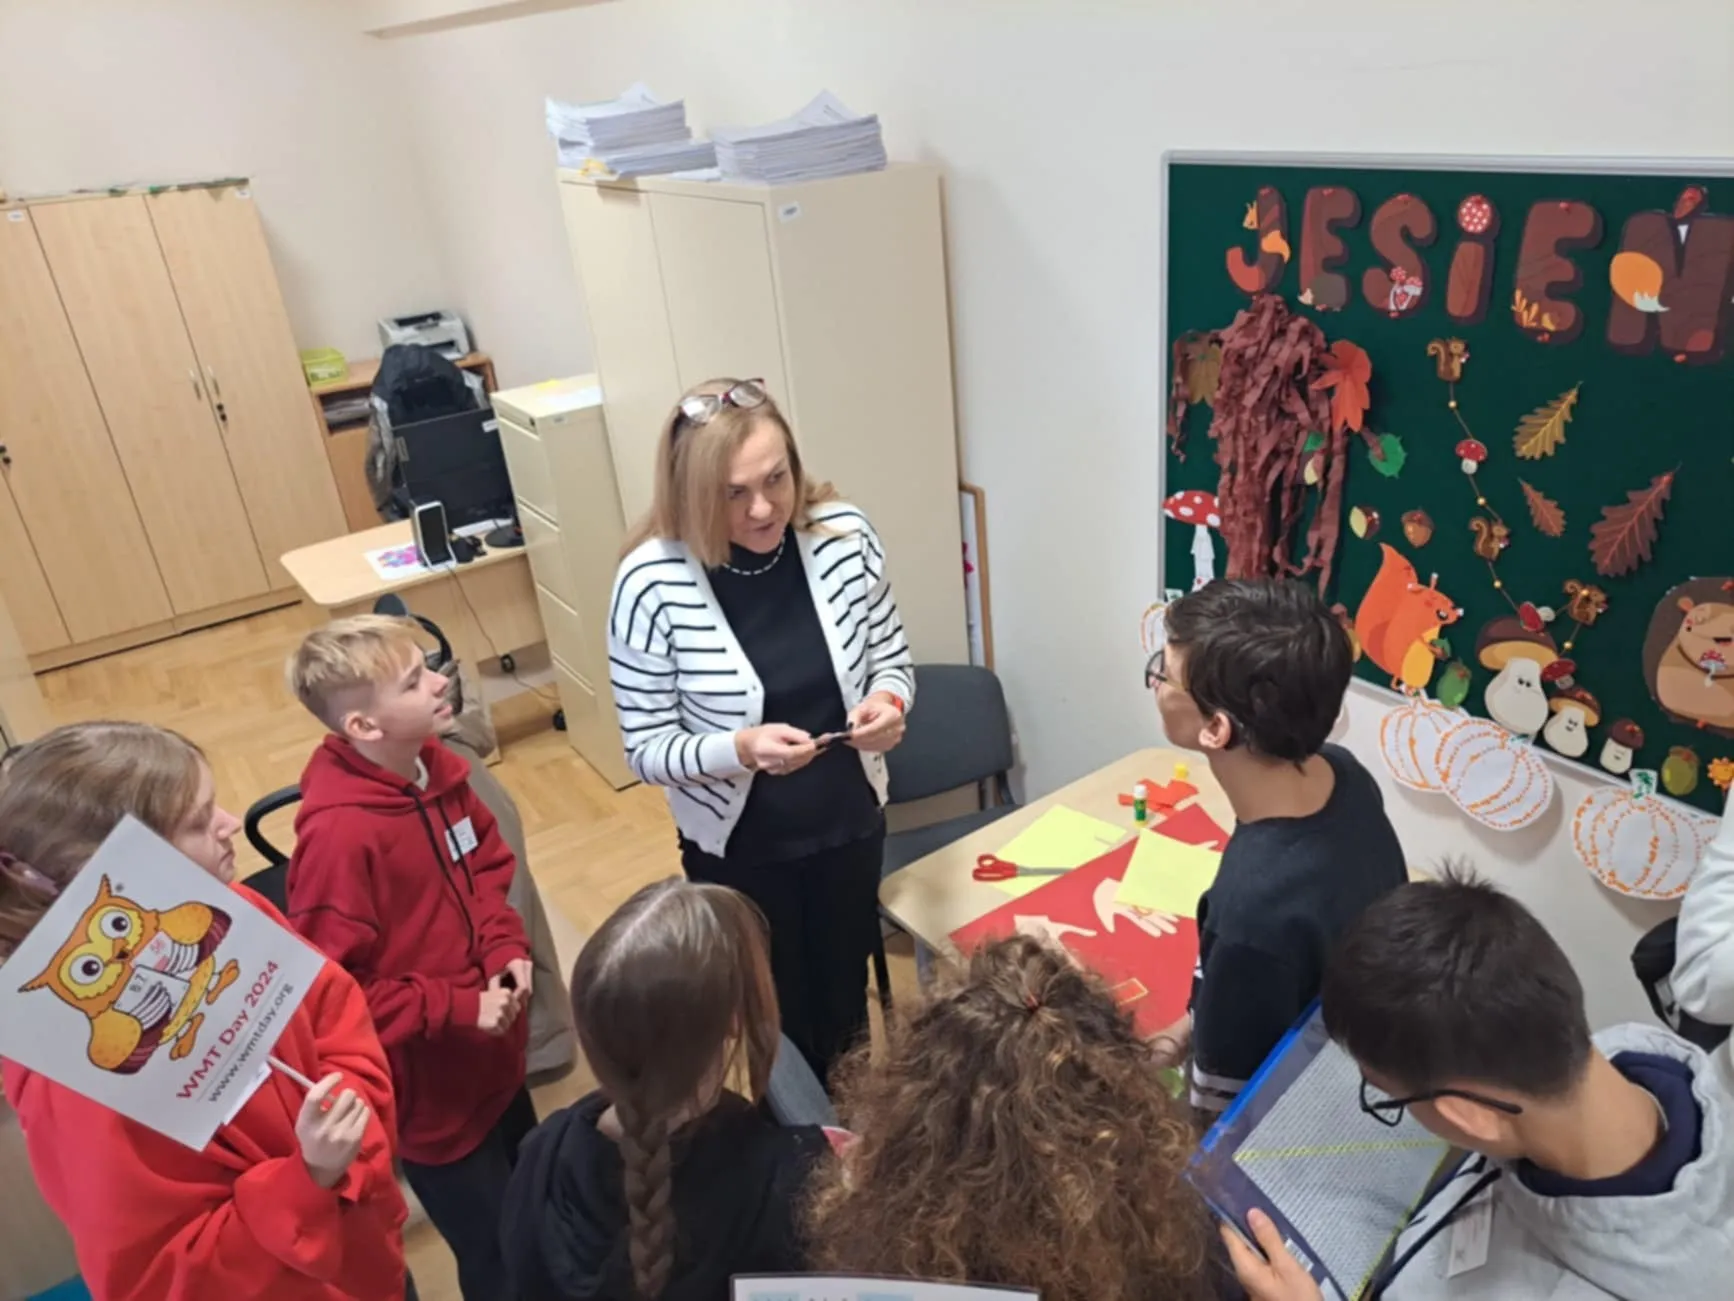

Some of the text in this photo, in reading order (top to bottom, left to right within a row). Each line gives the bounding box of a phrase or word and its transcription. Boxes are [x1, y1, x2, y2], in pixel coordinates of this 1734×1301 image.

[176, 960, 279, 1099] WMT Day 2024
[208, 983, 294, 1102] www.wmtday.org
